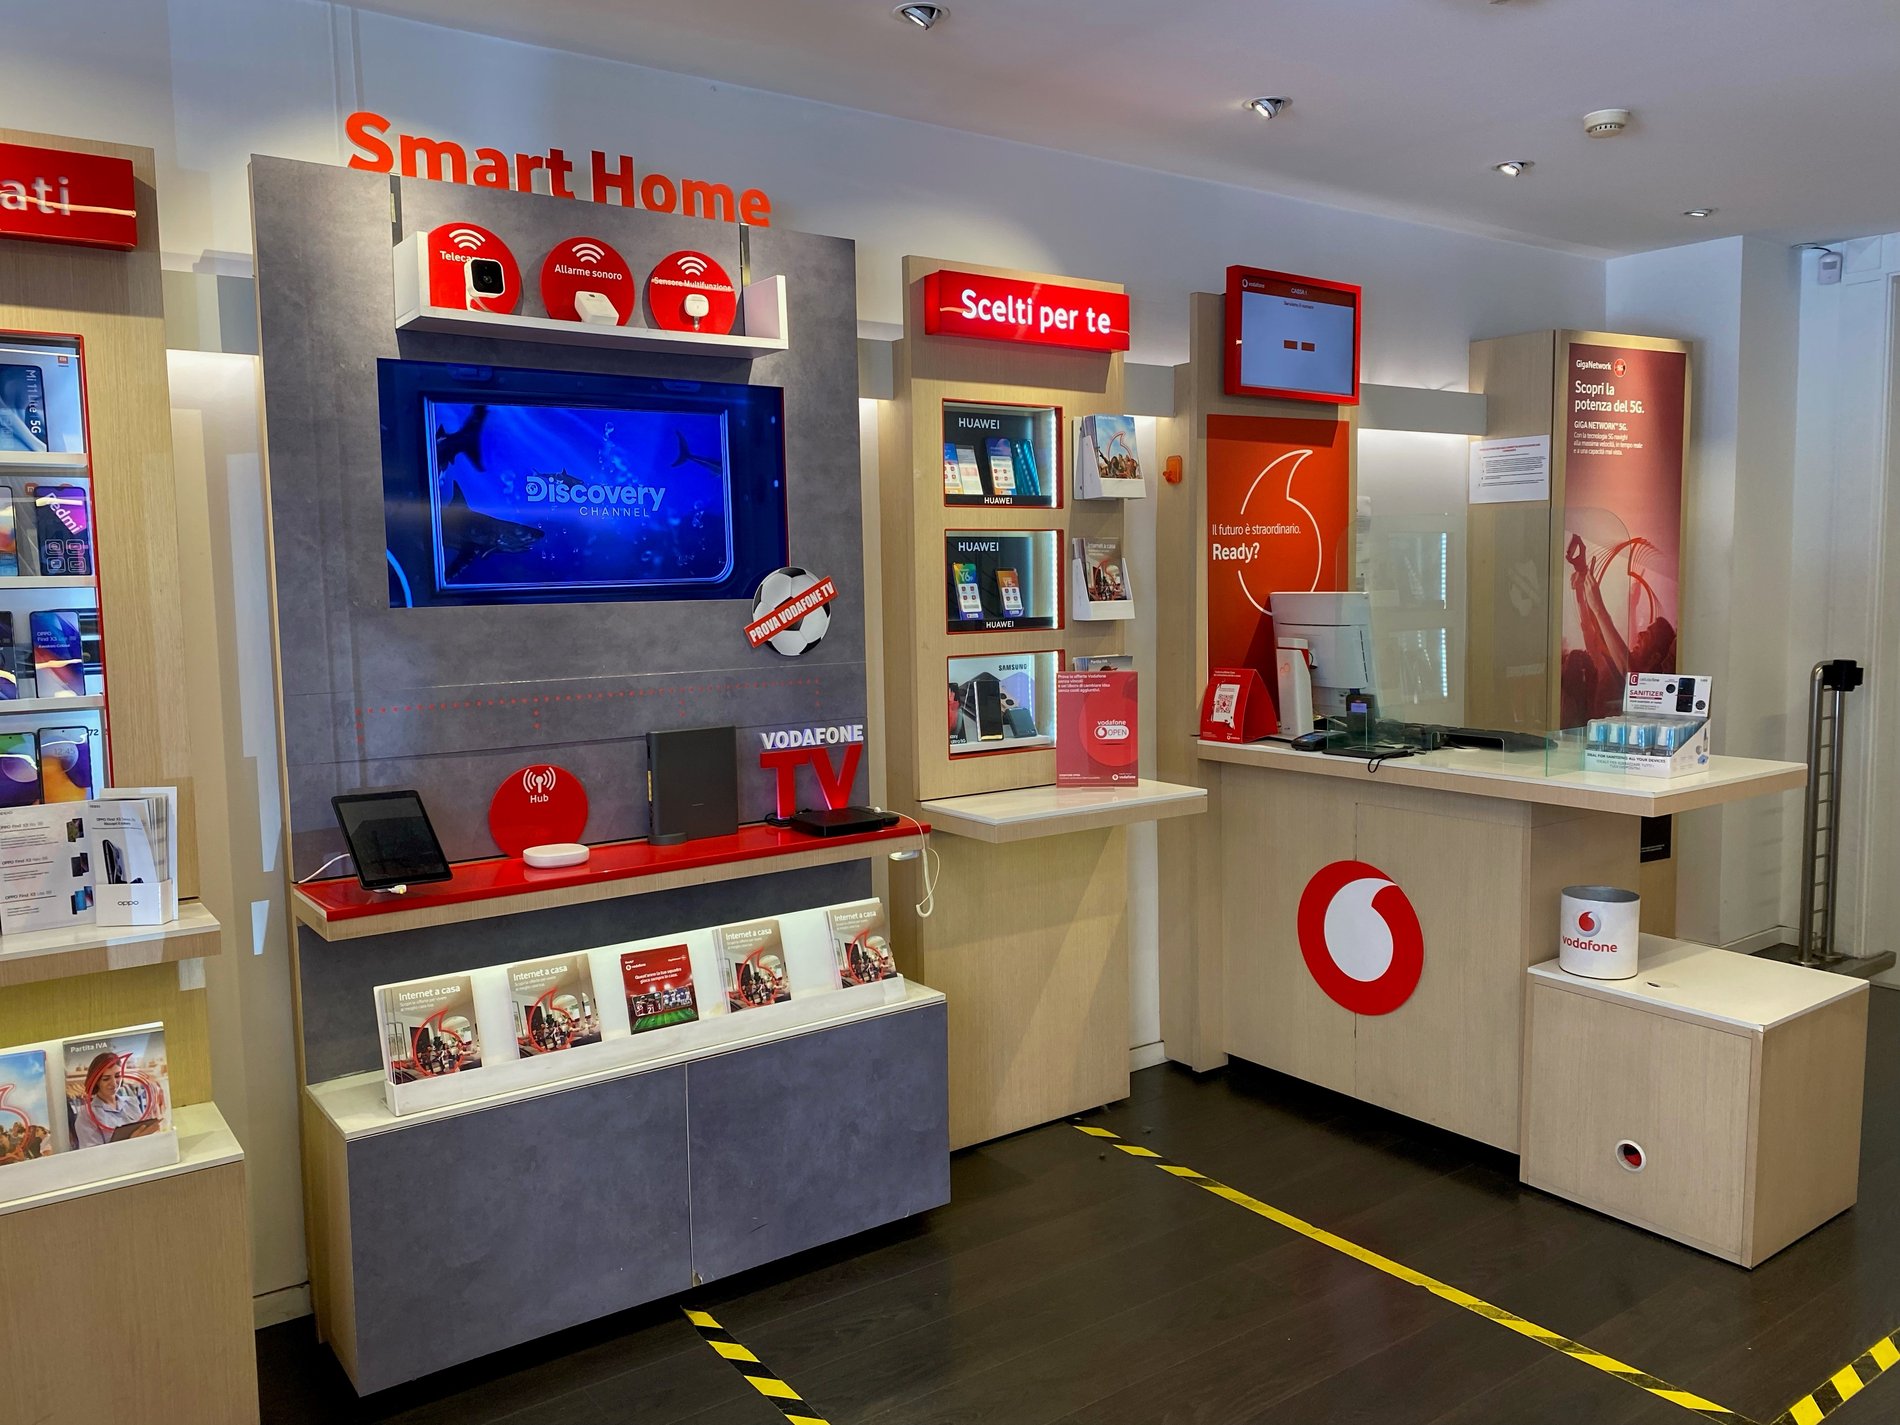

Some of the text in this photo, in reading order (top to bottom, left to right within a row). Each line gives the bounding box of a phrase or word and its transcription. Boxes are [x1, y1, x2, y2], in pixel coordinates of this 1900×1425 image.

[345, 111, 772, 228] Smart Home
[554, 264, 623, 280] Allarme sonoro
[654, 277, 732, 292] Sensore Multifunzione
[961, 289, 1111, 334] Scelti per te
[1576, 359, 1612, 370] GigaNetwork
[1575, 380, 1615, 397] Scopri la
[1575, 398, 1645, 414] potenza del 5G.
[30, 420, 42, 434] 5G
[958, 417, 1000, 430] HUAWEI
[1574, 421, 1587, 429] GIGA
[525, 476, 666, 511] Discovery
[984, 497, 1013, 505] HUAWEI
[579, 506, 649, 518] CHANNEL
[1212, 523, 1301, 536] Il futuro è straordinario.
[958, 542, 999, 552] HUAWEI
[1212, 542, 1260, 564] Ready?
[749, 581, 835, 643] PROVA VODAFONE TV
[986, 620, 1014, 629] HUAWEI
[998, 664, 1027, 672] SAMSUNG
[1629, 689, 1664, 697] SANITIZER
[761, 724, 864, 750] VODAFONE
[1107, 729, 1127, 737] OPEN
[759, 741, 864, 820] TV
[530, 793, 549, 804] Hub
[117, 899, 139, 907] oppo
[834, 912, 858, 922] Internet
[863, 910, 877, 918] casa
[725, 930, 752, 941] Internet
[757, 928, 773, 936] casa
[1562, 936, 1618, 953] vodafone
[513, 965, 568, 981] Internet a casa
[399, 989, 434, 1001] Internet
[441, 985, 461, 994] casa
[70, 1041, 108, 1053] Partita IVA
